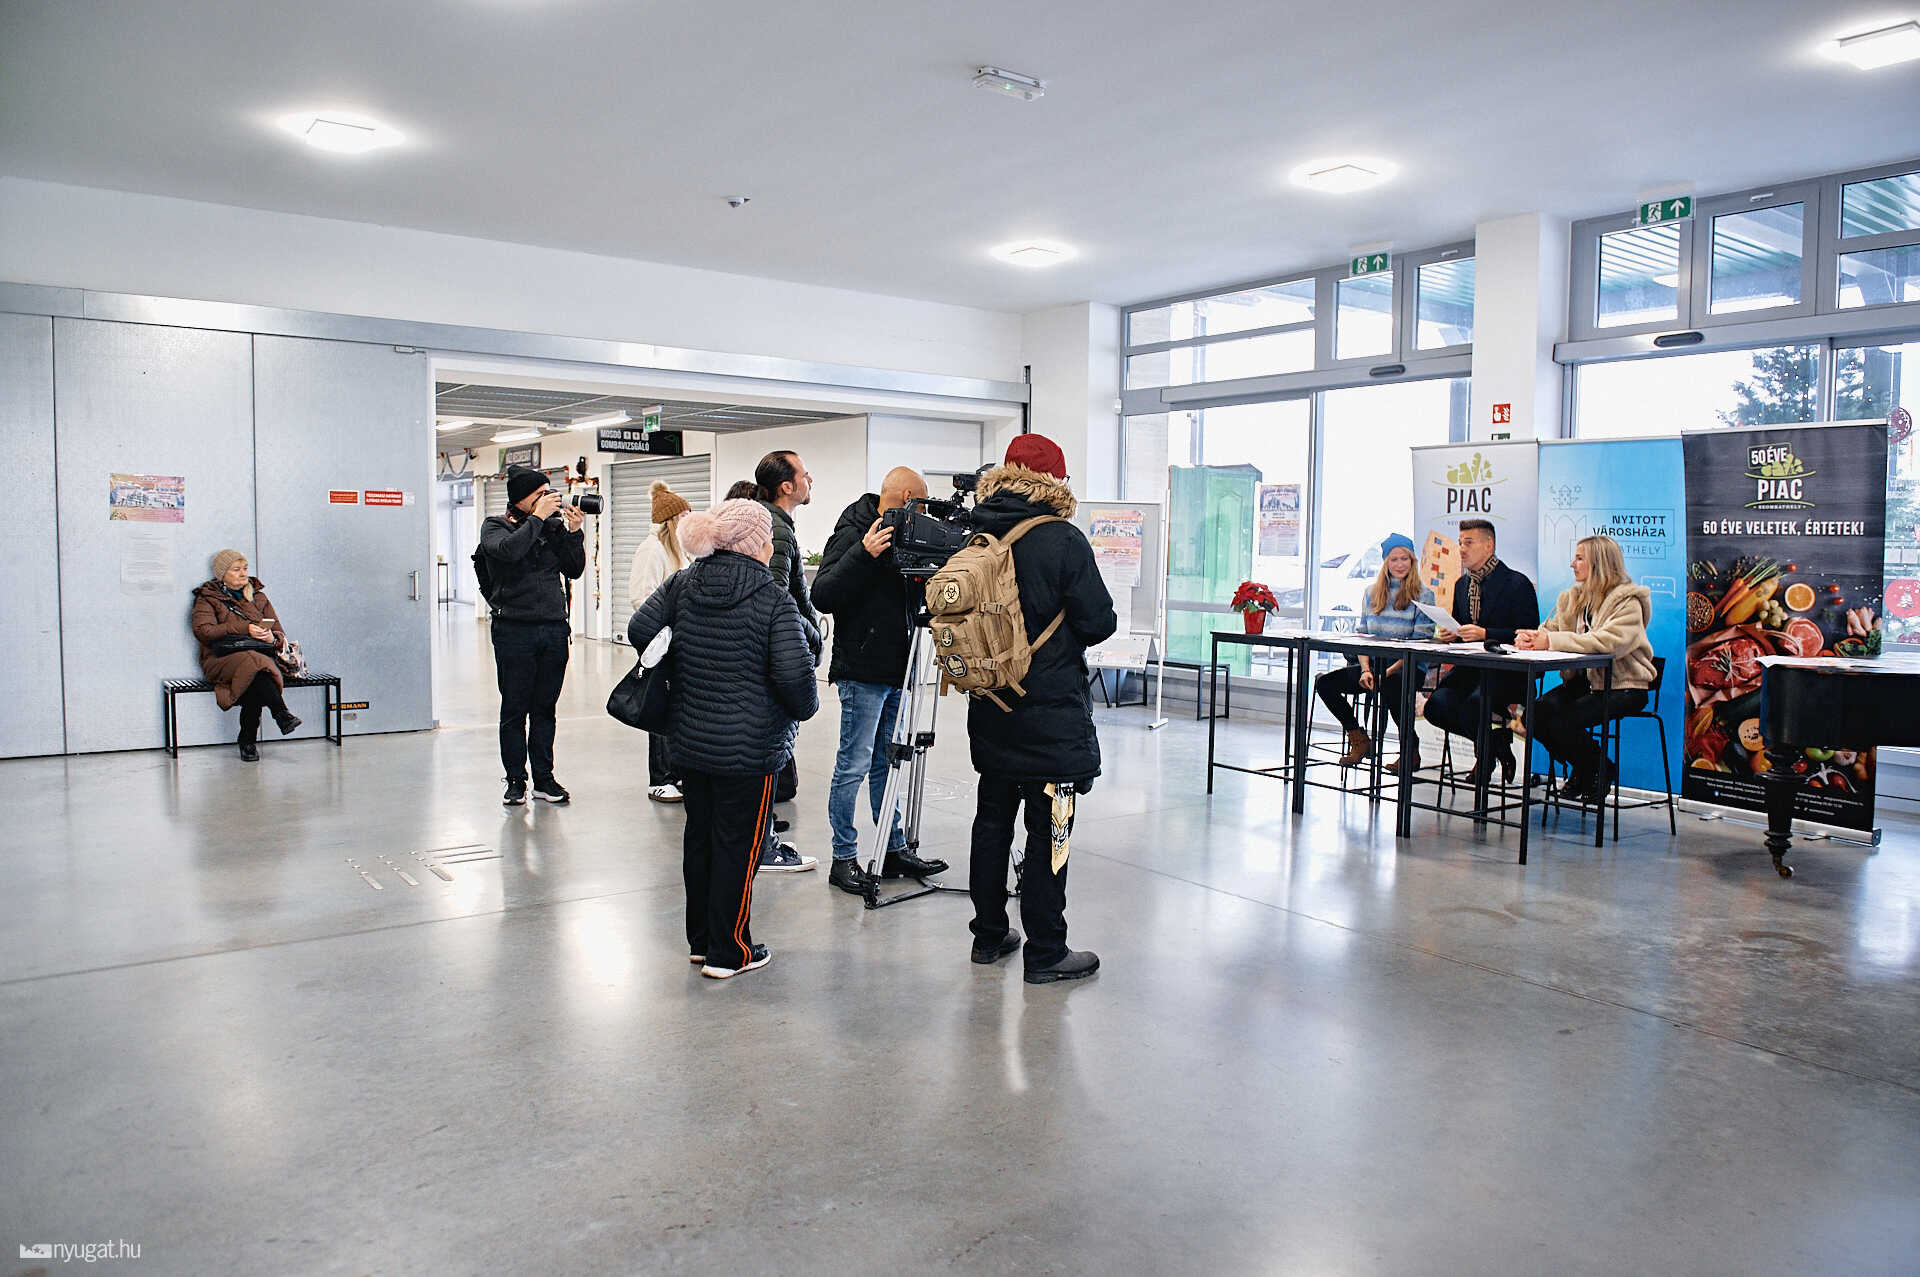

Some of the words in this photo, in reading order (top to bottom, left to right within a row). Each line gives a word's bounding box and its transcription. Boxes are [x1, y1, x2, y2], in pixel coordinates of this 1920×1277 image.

[1751, 450, 1766, 465] 50
[1767, 446, 1787, 462] ÉVE
[1757, 478, 1802, 500] PIAC
[1447, 487, 1491, 513] PIAC
[1612, 515, 1666, 525] NYITOTT
[1703, 520, 1718, 534] 50
[1721, 518, 1742, 534] ÉVE
[1746, 521, 1801, 536] VELETEK,
[1805, 518, 1864, 536] ÉRTETEK!
[1593, 525, 1666, 537] VÁROSHÁZA
